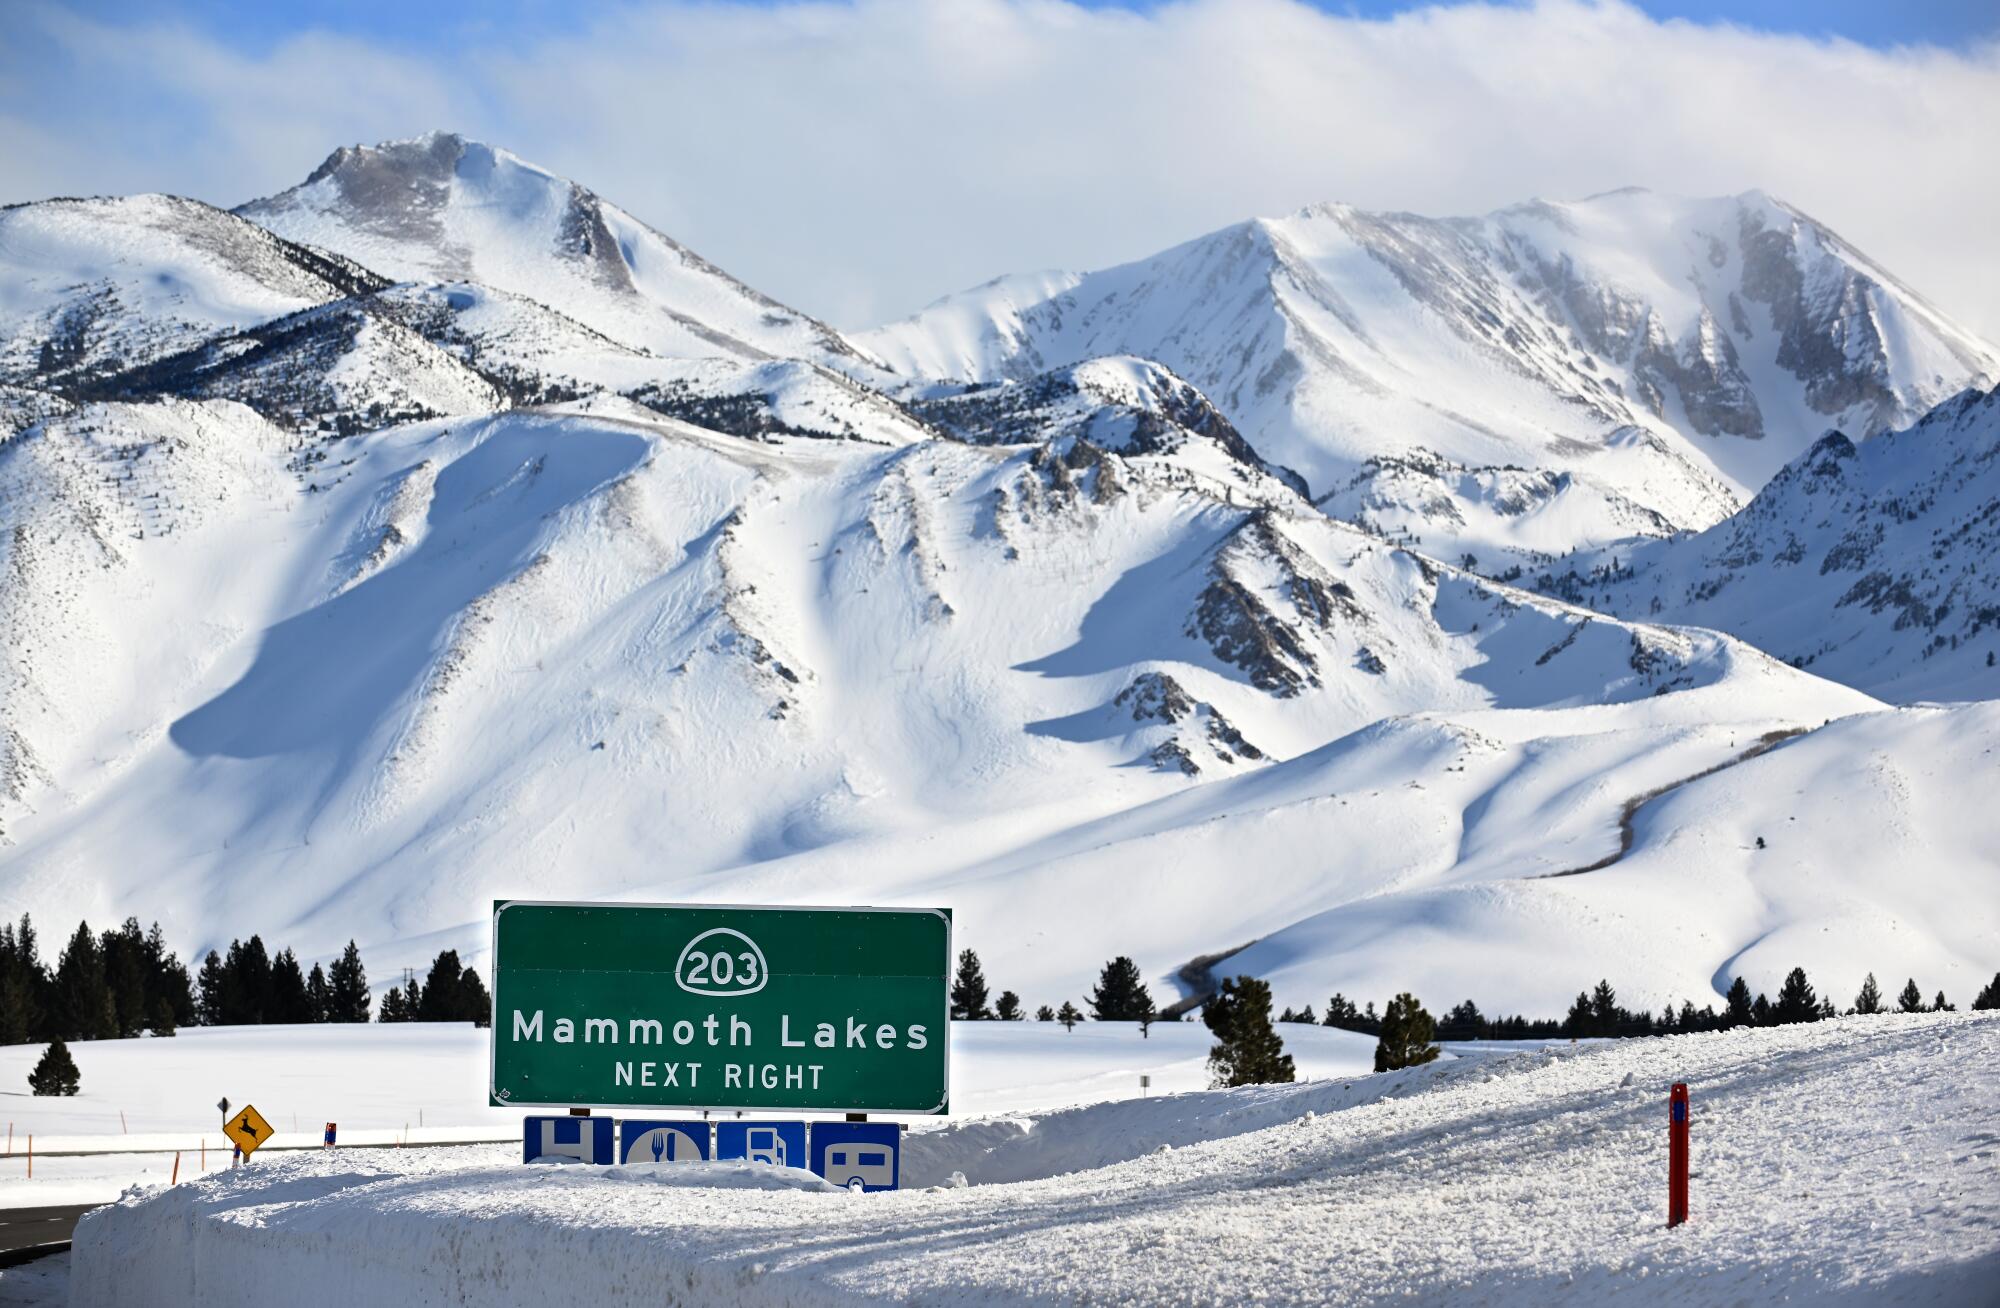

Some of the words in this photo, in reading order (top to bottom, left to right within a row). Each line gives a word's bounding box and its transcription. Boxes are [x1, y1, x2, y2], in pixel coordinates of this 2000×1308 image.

[686, 951, 759, 985] 203
[512, 1009, 752, 1046] Mammoth
[781, 1014, 928, 1050] Lakes
[615, 1061, 702, 1088] NEXT
[724, 1063, 824, 1090] RIGHT
